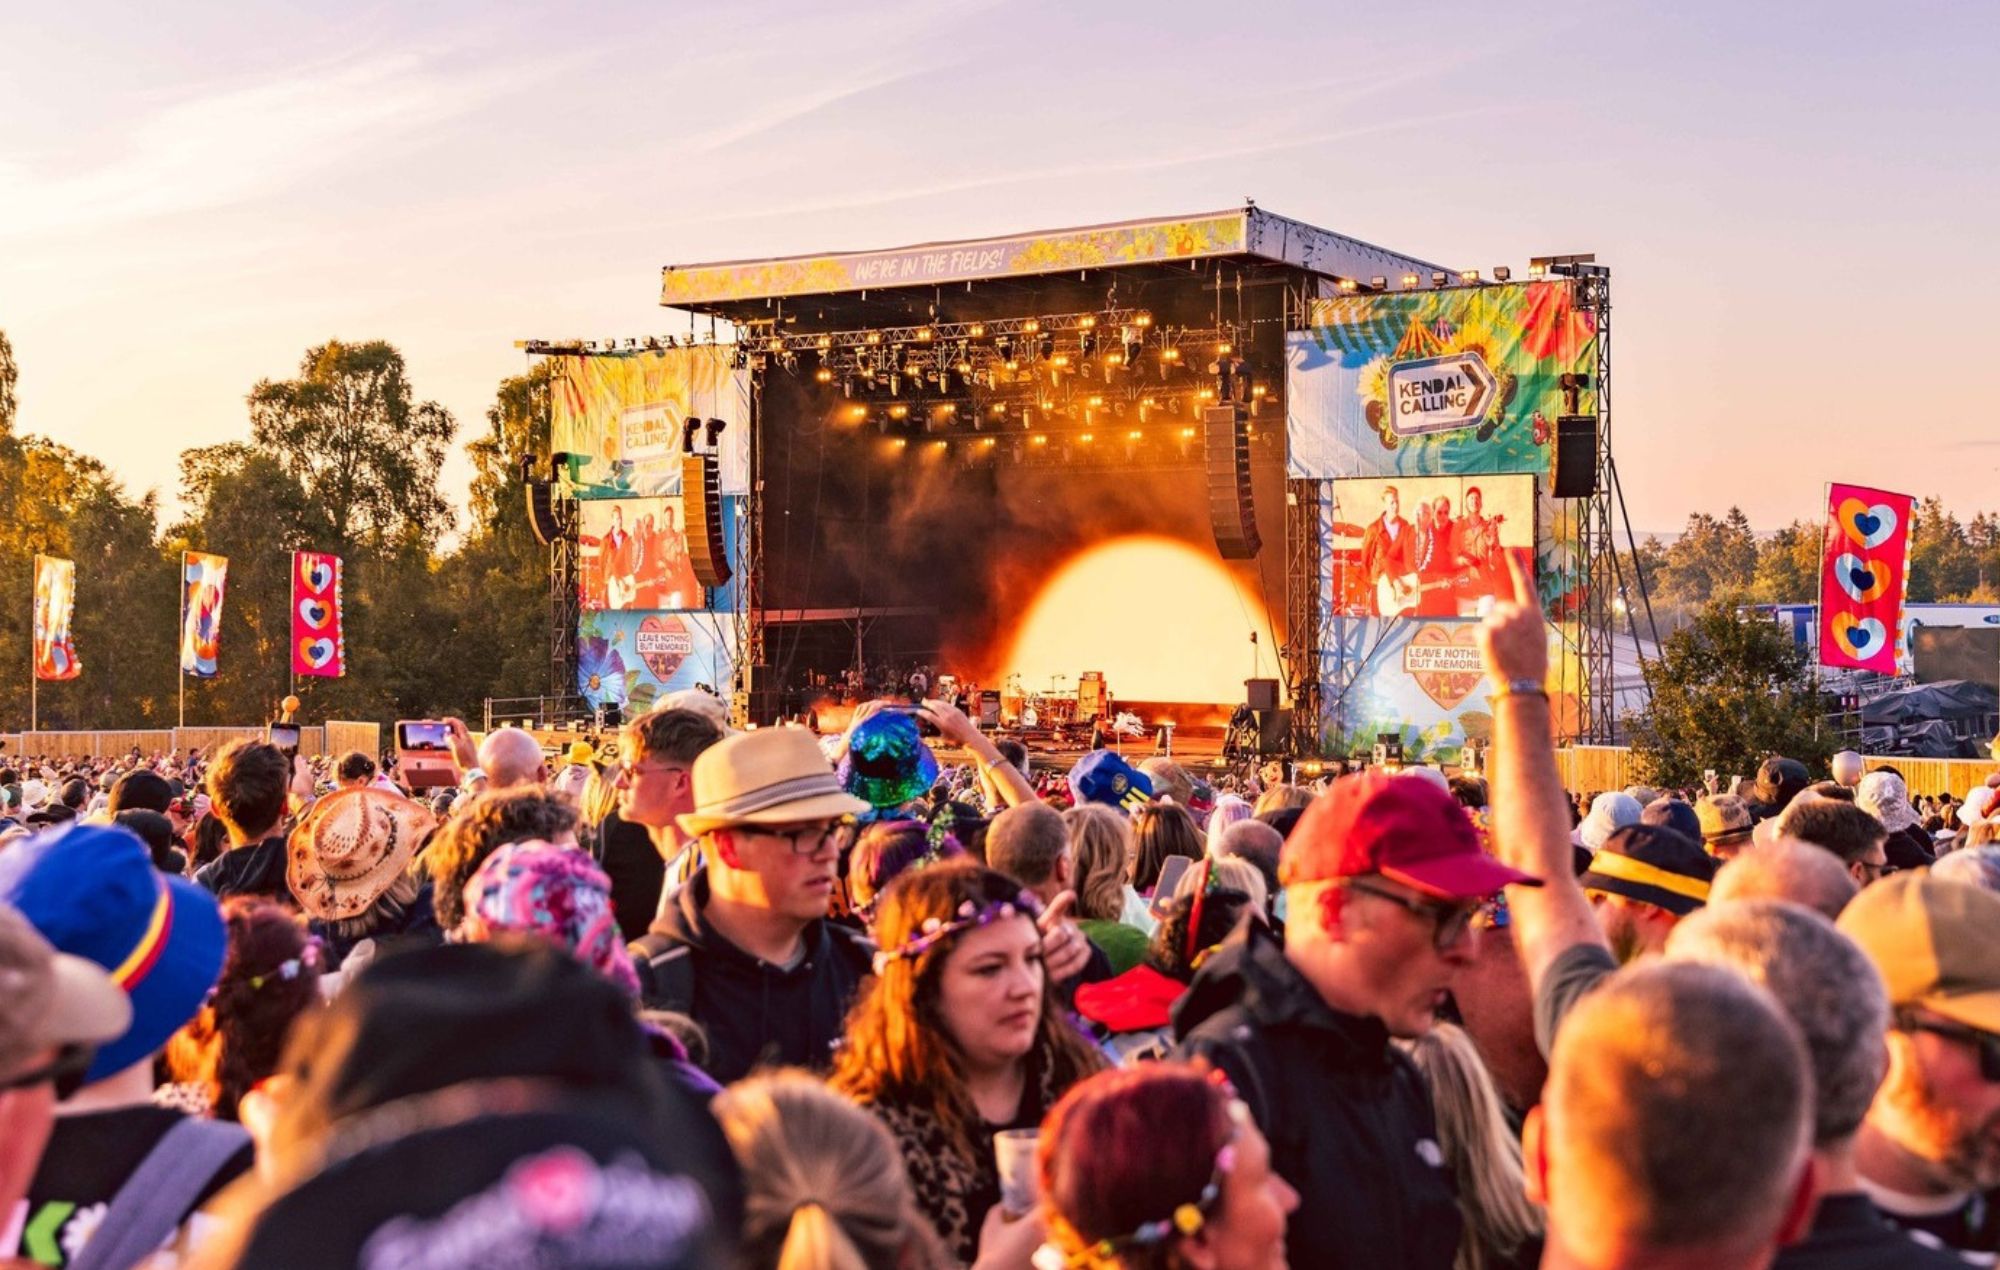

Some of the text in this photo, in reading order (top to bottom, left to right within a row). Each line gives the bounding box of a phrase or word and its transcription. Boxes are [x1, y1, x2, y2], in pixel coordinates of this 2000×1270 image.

[855, 247, 1006, 281] WE'RE IN THE FIELDS!
[1399, 374, 1466, 399] KENDAL
[1400, 392, 1467, 416] CALLING
[639, 633, 660, 642] LEAVE
[639, 642, 653, 650] BUT
[1408, 647, 1442, 658] LEAVE
[1409, 658, 1482, 670] BUT MEMORIE
